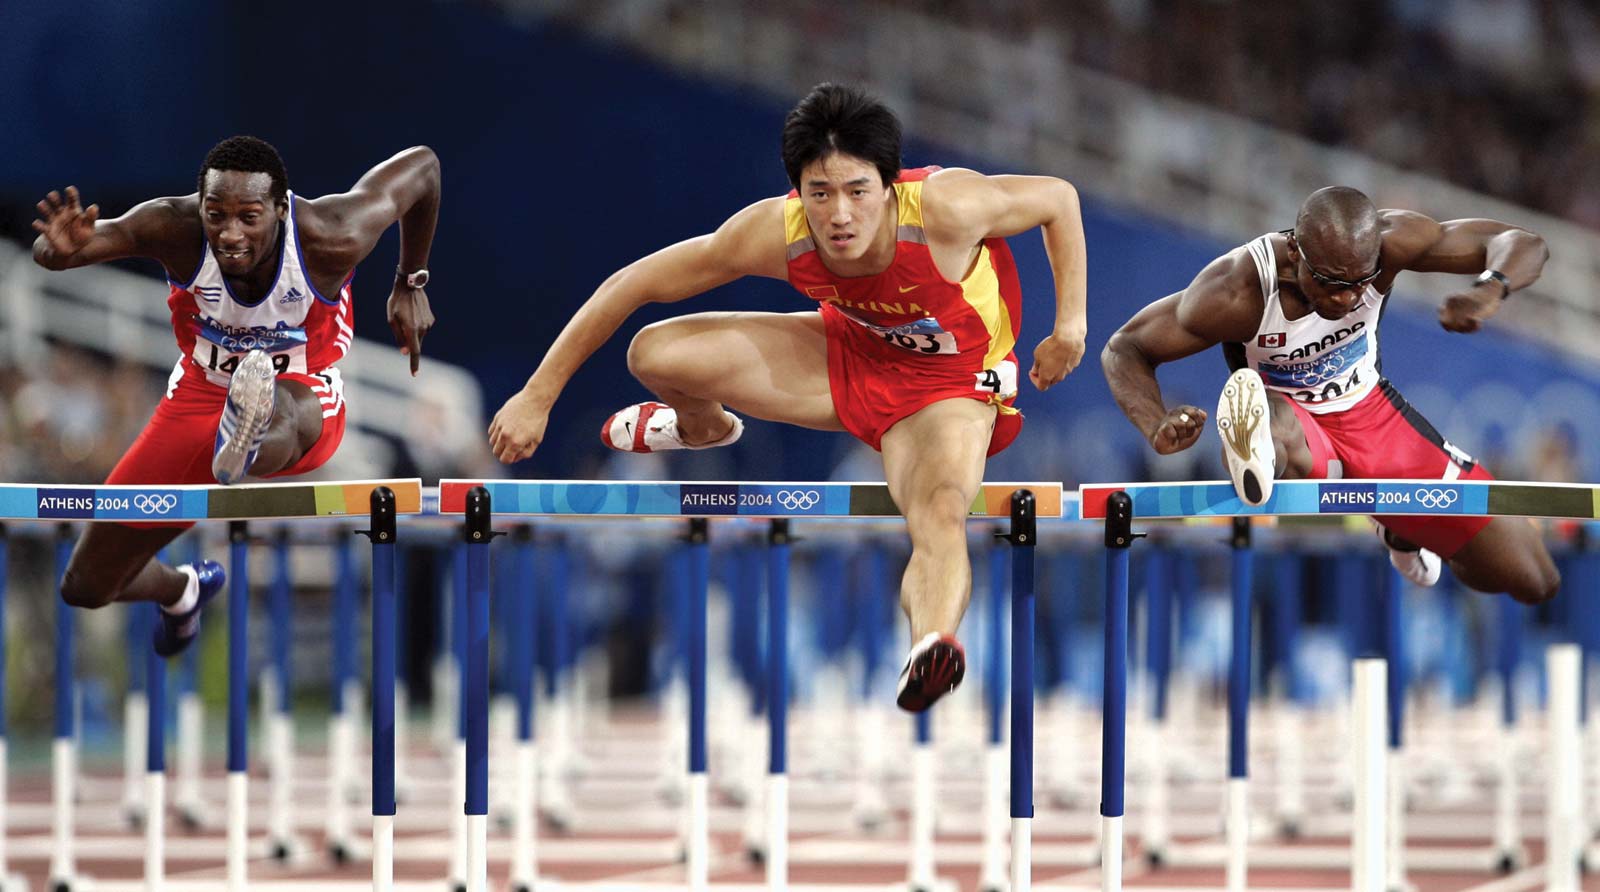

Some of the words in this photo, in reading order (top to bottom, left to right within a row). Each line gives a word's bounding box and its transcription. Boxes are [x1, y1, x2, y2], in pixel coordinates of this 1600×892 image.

[208, 344, 290, 374] 149
[982, 369, 1001, 393] 4
[39, 497, 93, 510] ATHENS
[96, 498, 129, 510] 2004
[682, 493, 737, 506] ATHENS
[739, 494, 773, 506] 2004
[1320, 491, 1375, 504] ATHENS
[1378, 492, 1411, 504] 2004
